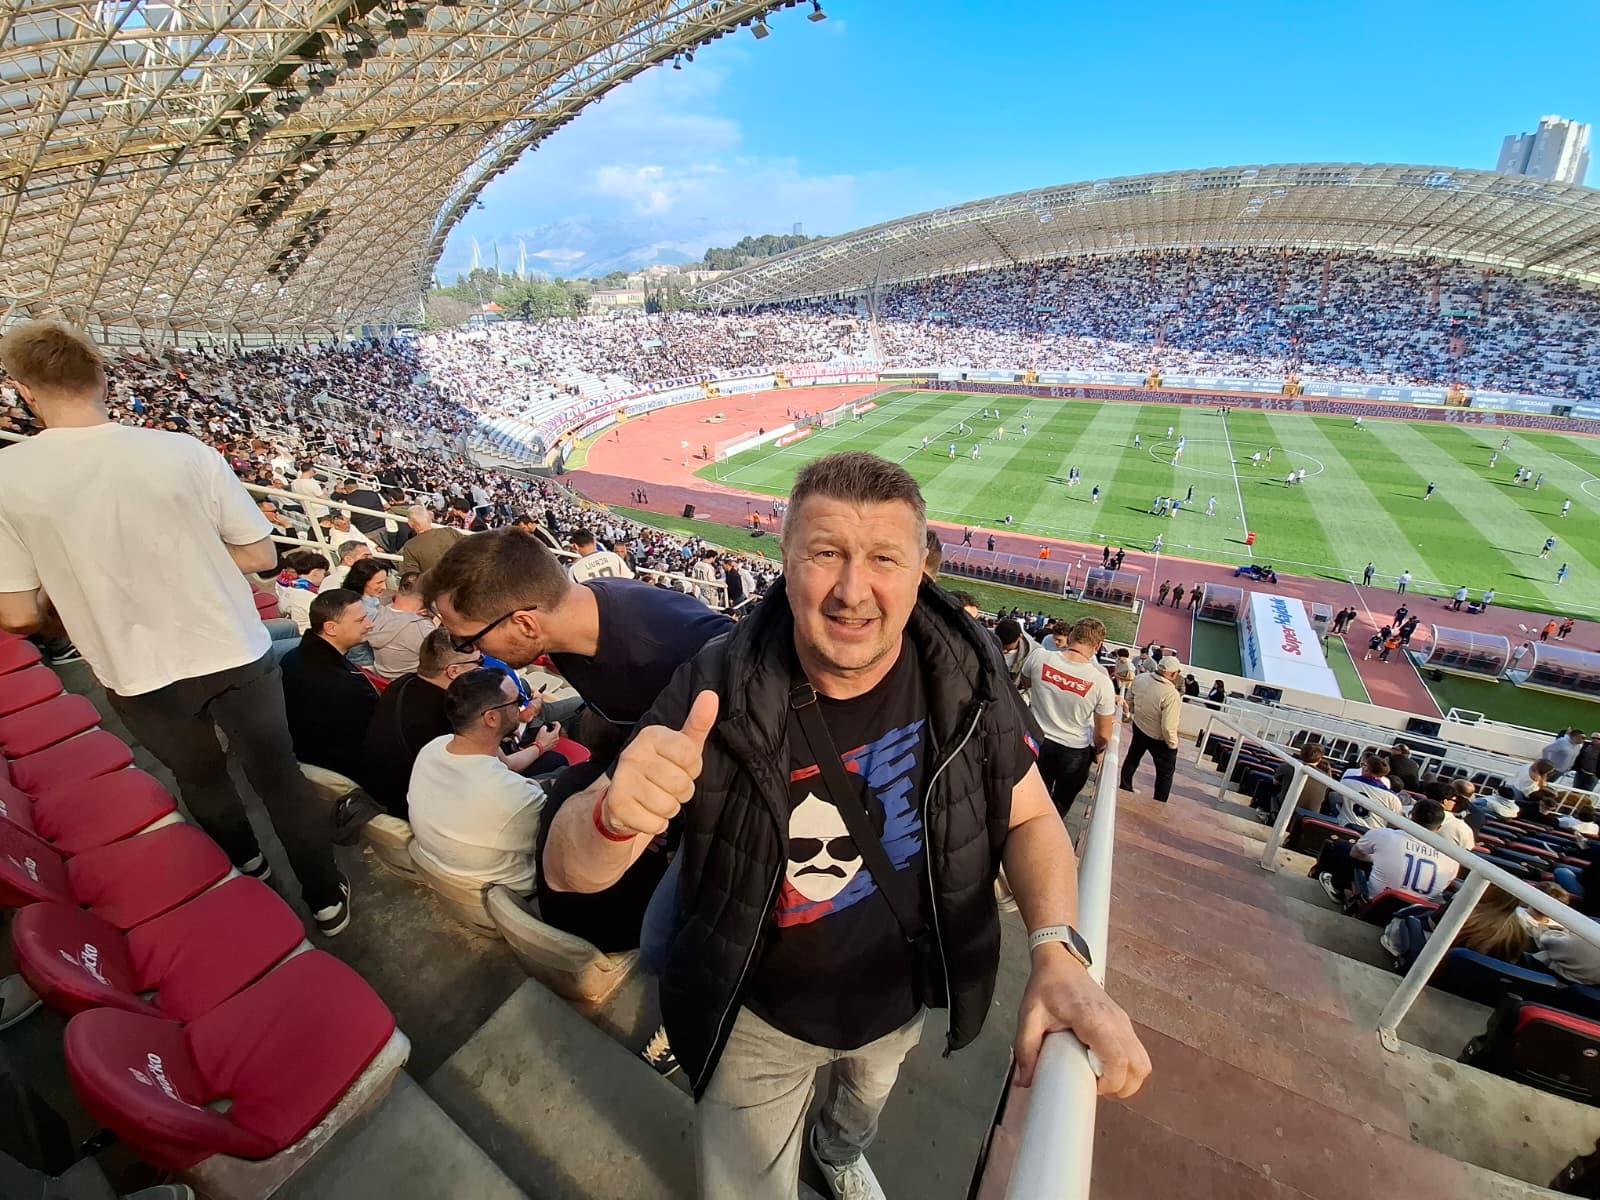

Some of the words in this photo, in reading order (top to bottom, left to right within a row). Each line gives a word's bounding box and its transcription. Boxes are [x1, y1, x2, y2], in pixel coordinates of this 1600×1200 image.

[656, 373, 718, 389] TORCIDA
[729, 366, 769, 378] SPLIT
[1269, 597, 1293, 625] Hajduk
[1281, 625, 1303, 656] Super
[1405, 841, 1440, 859] LIVAJA
[1403, 853, 1437, 894] 10
